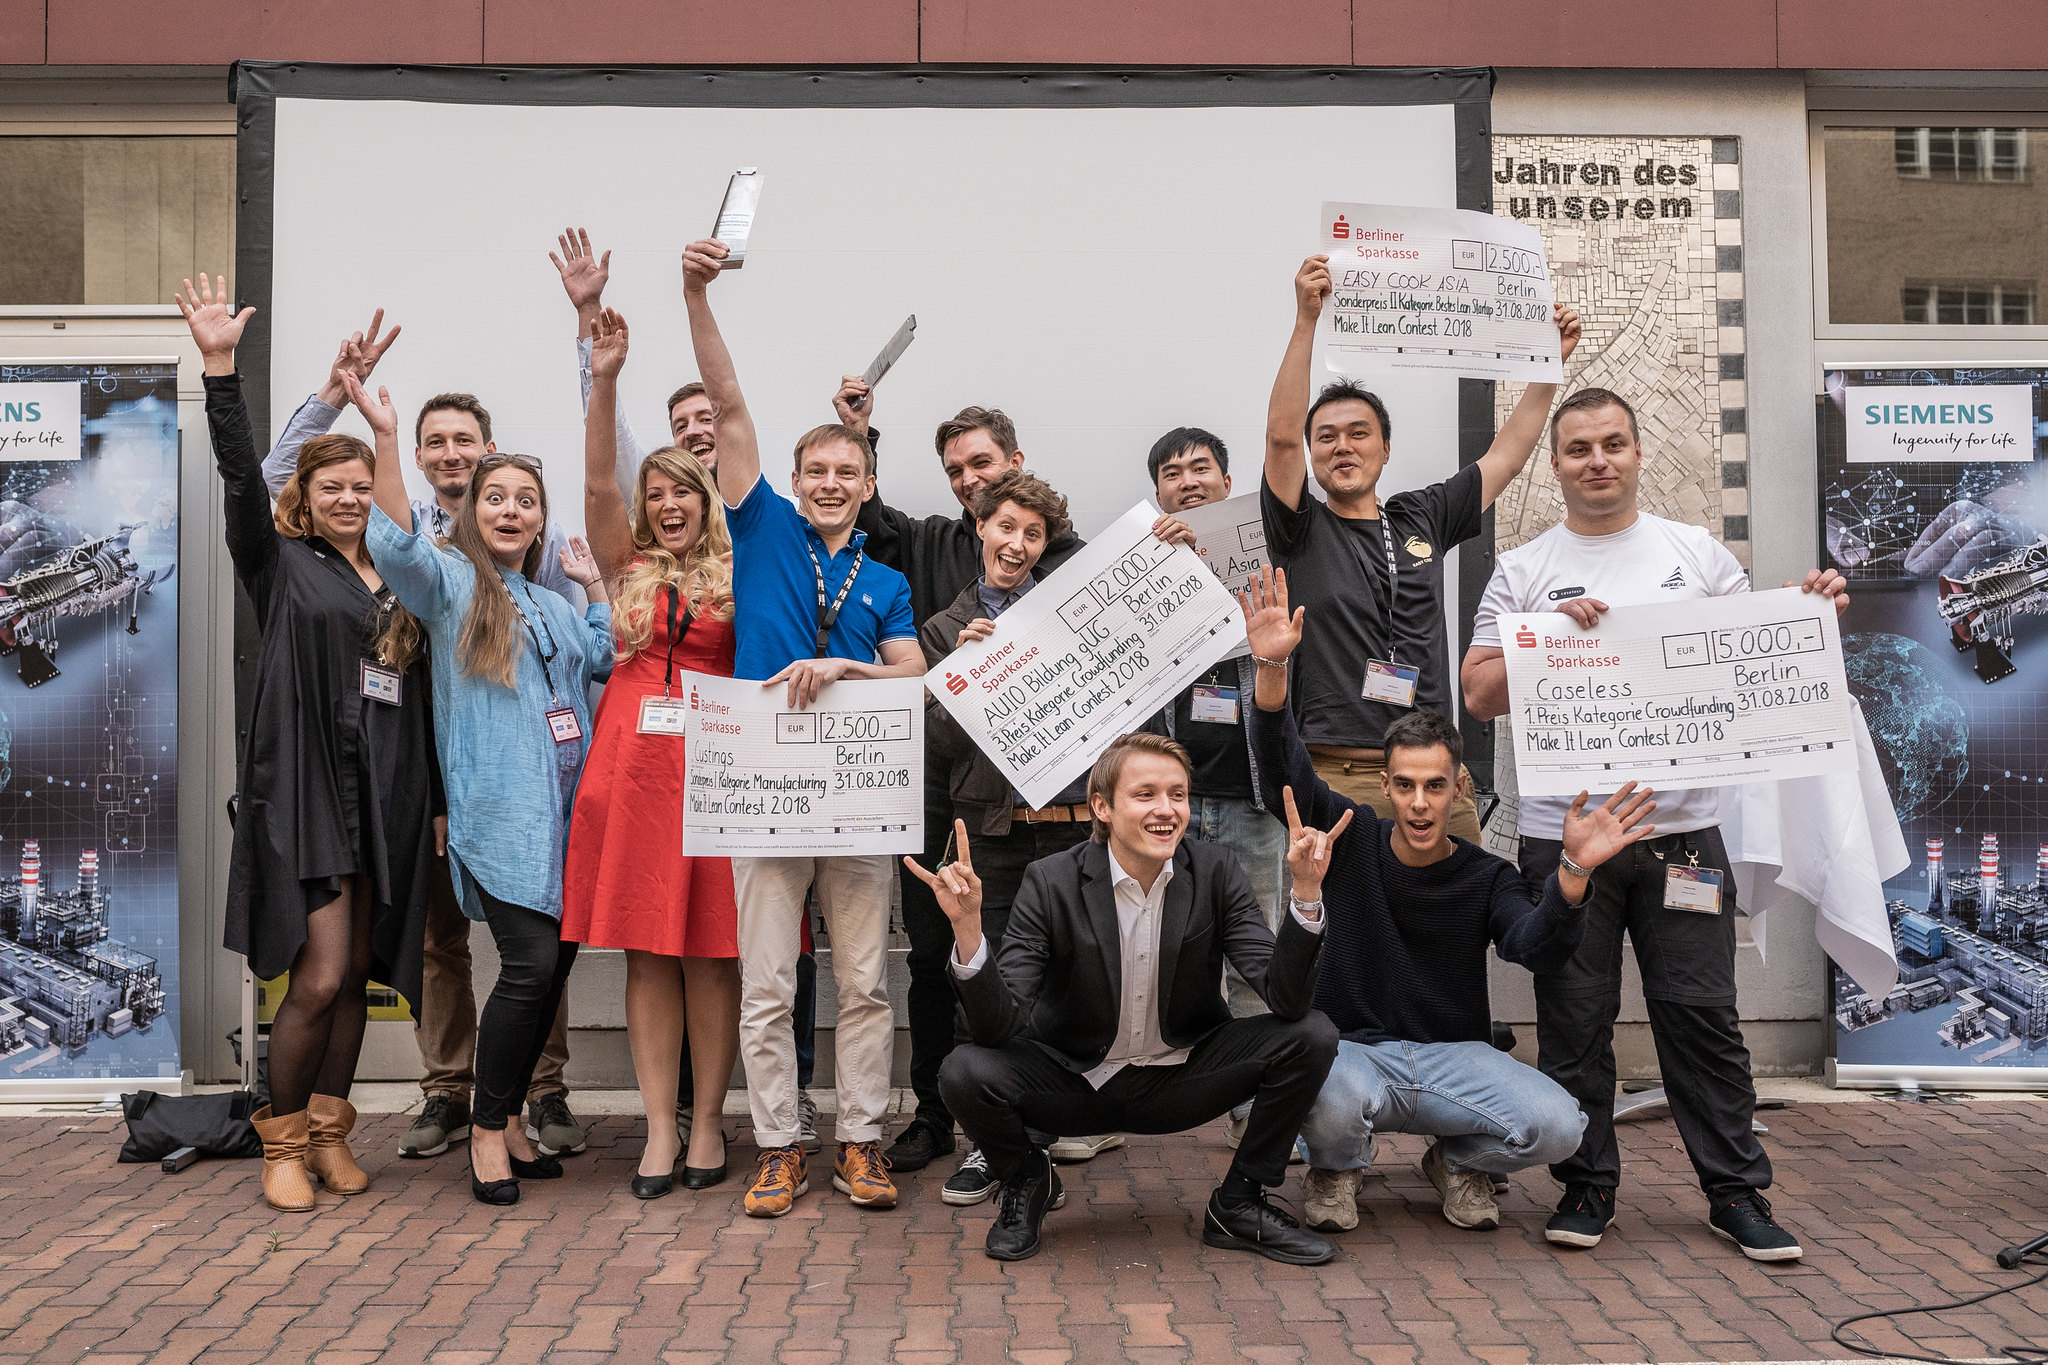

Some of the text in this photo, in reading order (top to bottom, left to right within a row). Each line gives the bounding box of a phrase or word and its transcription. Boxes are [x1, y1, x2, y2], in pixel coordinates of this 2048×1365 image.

[1494, 157, 1698, 186] Jahren des
[1509, 196, 1692, 220] unserem
[1356, 228, 1405, 242] Berliner
[1356, 246, 1420, 260] Sparkasse
[1462, 251, 1475, 259] EUR
[1342, 270, 1380, 289] EASY
[1387, 272, 1432, 289] COOK
[1497, 275, 1537, 298] Berlin
[1333, 291, 1388, 312] Sonderpreis
[1389, 291, 1397, 310] II
[1399, 292, 1435, 317] Kategorie
[1435, 295, 1456, 313] Bestes
[1456, 296, 1471, 315] Lean
[1495, 300, 1547, 322] 31.08.2018
[1334, 314, 1473, 338] Make It Lean Contest 2018
[0, 402, 42, 422] NS
[1865, 404, 1994, 425] SIEMENS
[12, 431, 37, 448] for
[39, 431, 65, 448] life
[1892, 432, 2017, 454] Ingenuity for life
[1249, 530, 1265, 540] EUR
[1097, 543, 1162, 601] 2.000,-
[1227, 553, 1261, 577] Asia
[1122, 574, 1173, 614] Berlin
[1138, 574, 1203, 633] 31.08.2018
[1072, 603, 1089, 619] EUR
[1544, 635, 1600, 650] Berliner
[1676, 646, 1696, 656] EUR
[1719, 626, 1815, 659] 5.000,-
[969, 639, 1016, 681] Berliner
[1022, 652, 1082, 693] Bildung
[1078, 619, 1110, 662] gUG
[1547, 653, 1621, 670] Sparkasse
[982, 644, 1040, 694] Sparkasse
[1023, 684, 1075, 726] Kategorie
[1071, 632, 1145, 688] Crowdfunding
[1734, 659, 1800, 687] Berlin
[1536, 677, 1633, 701] Caseless
[1737, 681, 1829, 711] 31.08.2018
[701, 699, 730, 715] Berliner
[1006, 744, 1041, 772] Make
[1033, 731, 1051, 750] It
[1042, 717, 1075, 742] Lean
[1071, 678, 1116, 719] Contest
[1108, 650, 1150, 689] 2018
[1573, 703, 1642, 729] Kategorie
[1644, 696, 1734, 722] Crowdfunding
[701, 718, 741, 735] Sparkasse
[787, 724, 805, 733] EUR
[825, 715, 902, 740] 2.500,-
[1526, 720, 1724, 751] Make It Lean Contest 2018
[695, 740, 734, 774] Custings
[836, 744, 885, 765] Berlin
[719, 771, 750, 796] Kategorie
[754, 773, 827, 799] Manufacturing
[834, 769, 910, 789] 31.08.2018
[689, 793, 702, 813] Make
[708, 794, 722, 814] Lean
[724, 794, 766, 815] Contest
[770, 795, 811, 815] 2018
